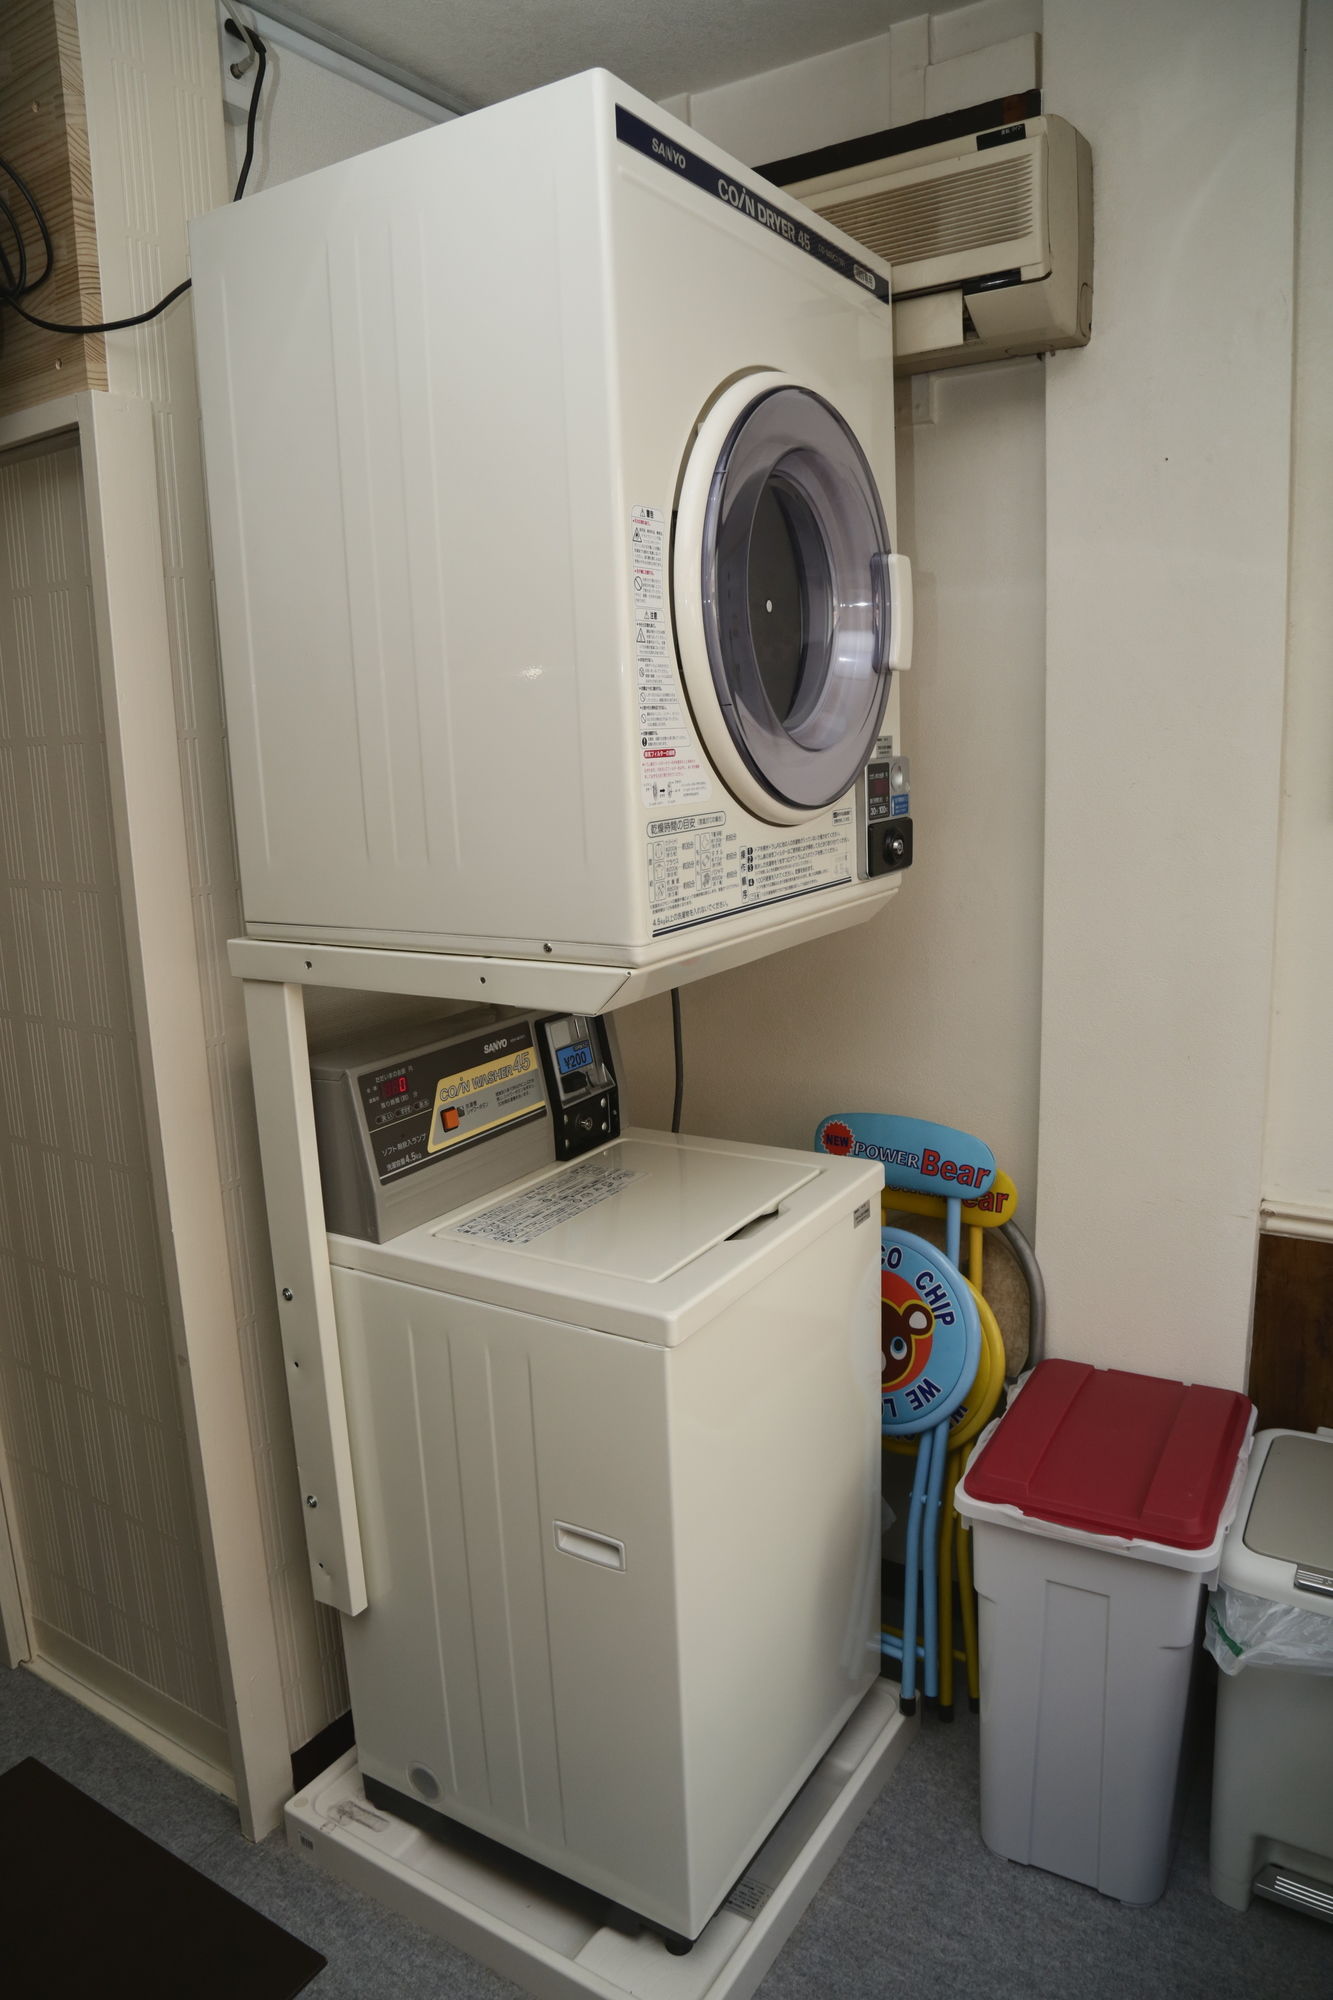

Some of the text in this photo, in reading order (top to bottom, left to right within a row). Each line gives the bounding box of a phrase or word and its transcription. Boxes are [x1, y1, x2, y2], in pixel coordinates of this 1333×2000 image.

[651, 137, 686, 169] SANYO
[757, 205, 796, 244] DRYER
[797, 230, 811, 252] 45
[650, 818, 696, 835] 乾燥時間の目安
[483, 1038, 508, 1055] SANYO
[471, 1063, 514, 1090] WASHER
[513, 1051, 532, 1074] 45
[563, 1051, 587, 1069] ¥200
[399, 1077, 407, 1093] 0
[825, 1134, 849, 1147] NEW
[854, 1141, 991, 1189] POWER Bear
[915, 1271, 955, 1326] CHIP
[905, 1378, 941, 1411] WE
